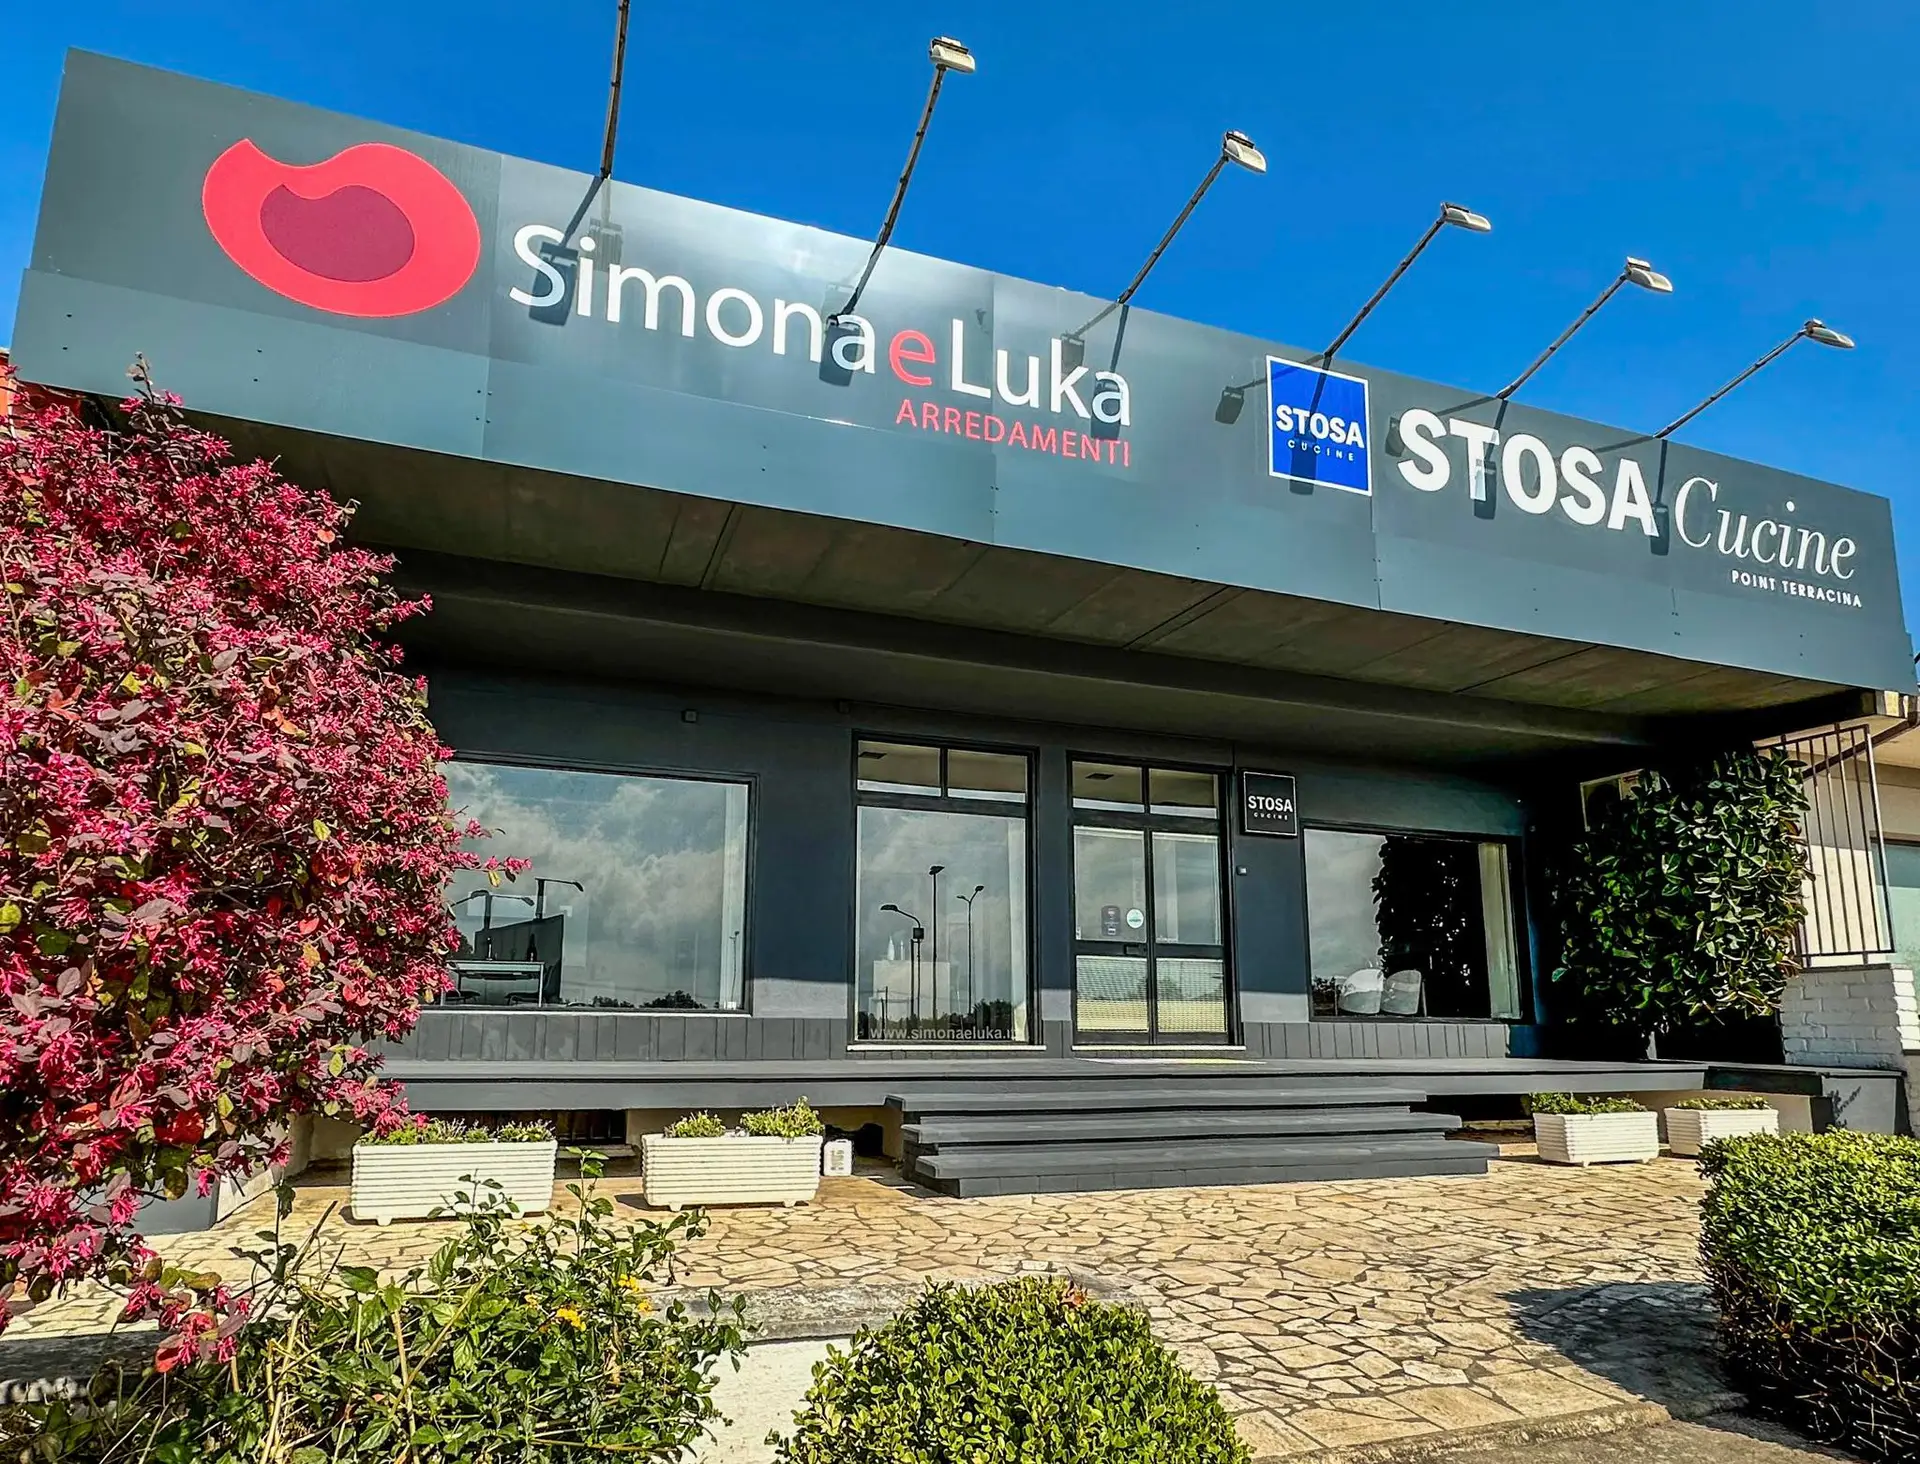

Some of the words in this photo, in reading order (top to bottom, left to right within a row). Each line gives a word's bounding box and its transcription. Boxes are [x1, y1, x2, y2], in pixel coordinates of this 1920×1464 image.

[509, 223, 876, 374] Simona
[951, 319, 1131, 426] Luka
[896, 399, 1131, 468] ARREDAMENTI
[1276, 404, 1365, 449] STOSA
[1287, 439, 1355, 462] CUCINE
[1397, 408, 1660, 538] STOSA
[1675, 477, 1856, 580] Cucine
[1731, 569, 1776, 591] POINT
[1782, 579, 1862, 608] TERRACINA
[1248, 795, 1293, 813] STOSA
